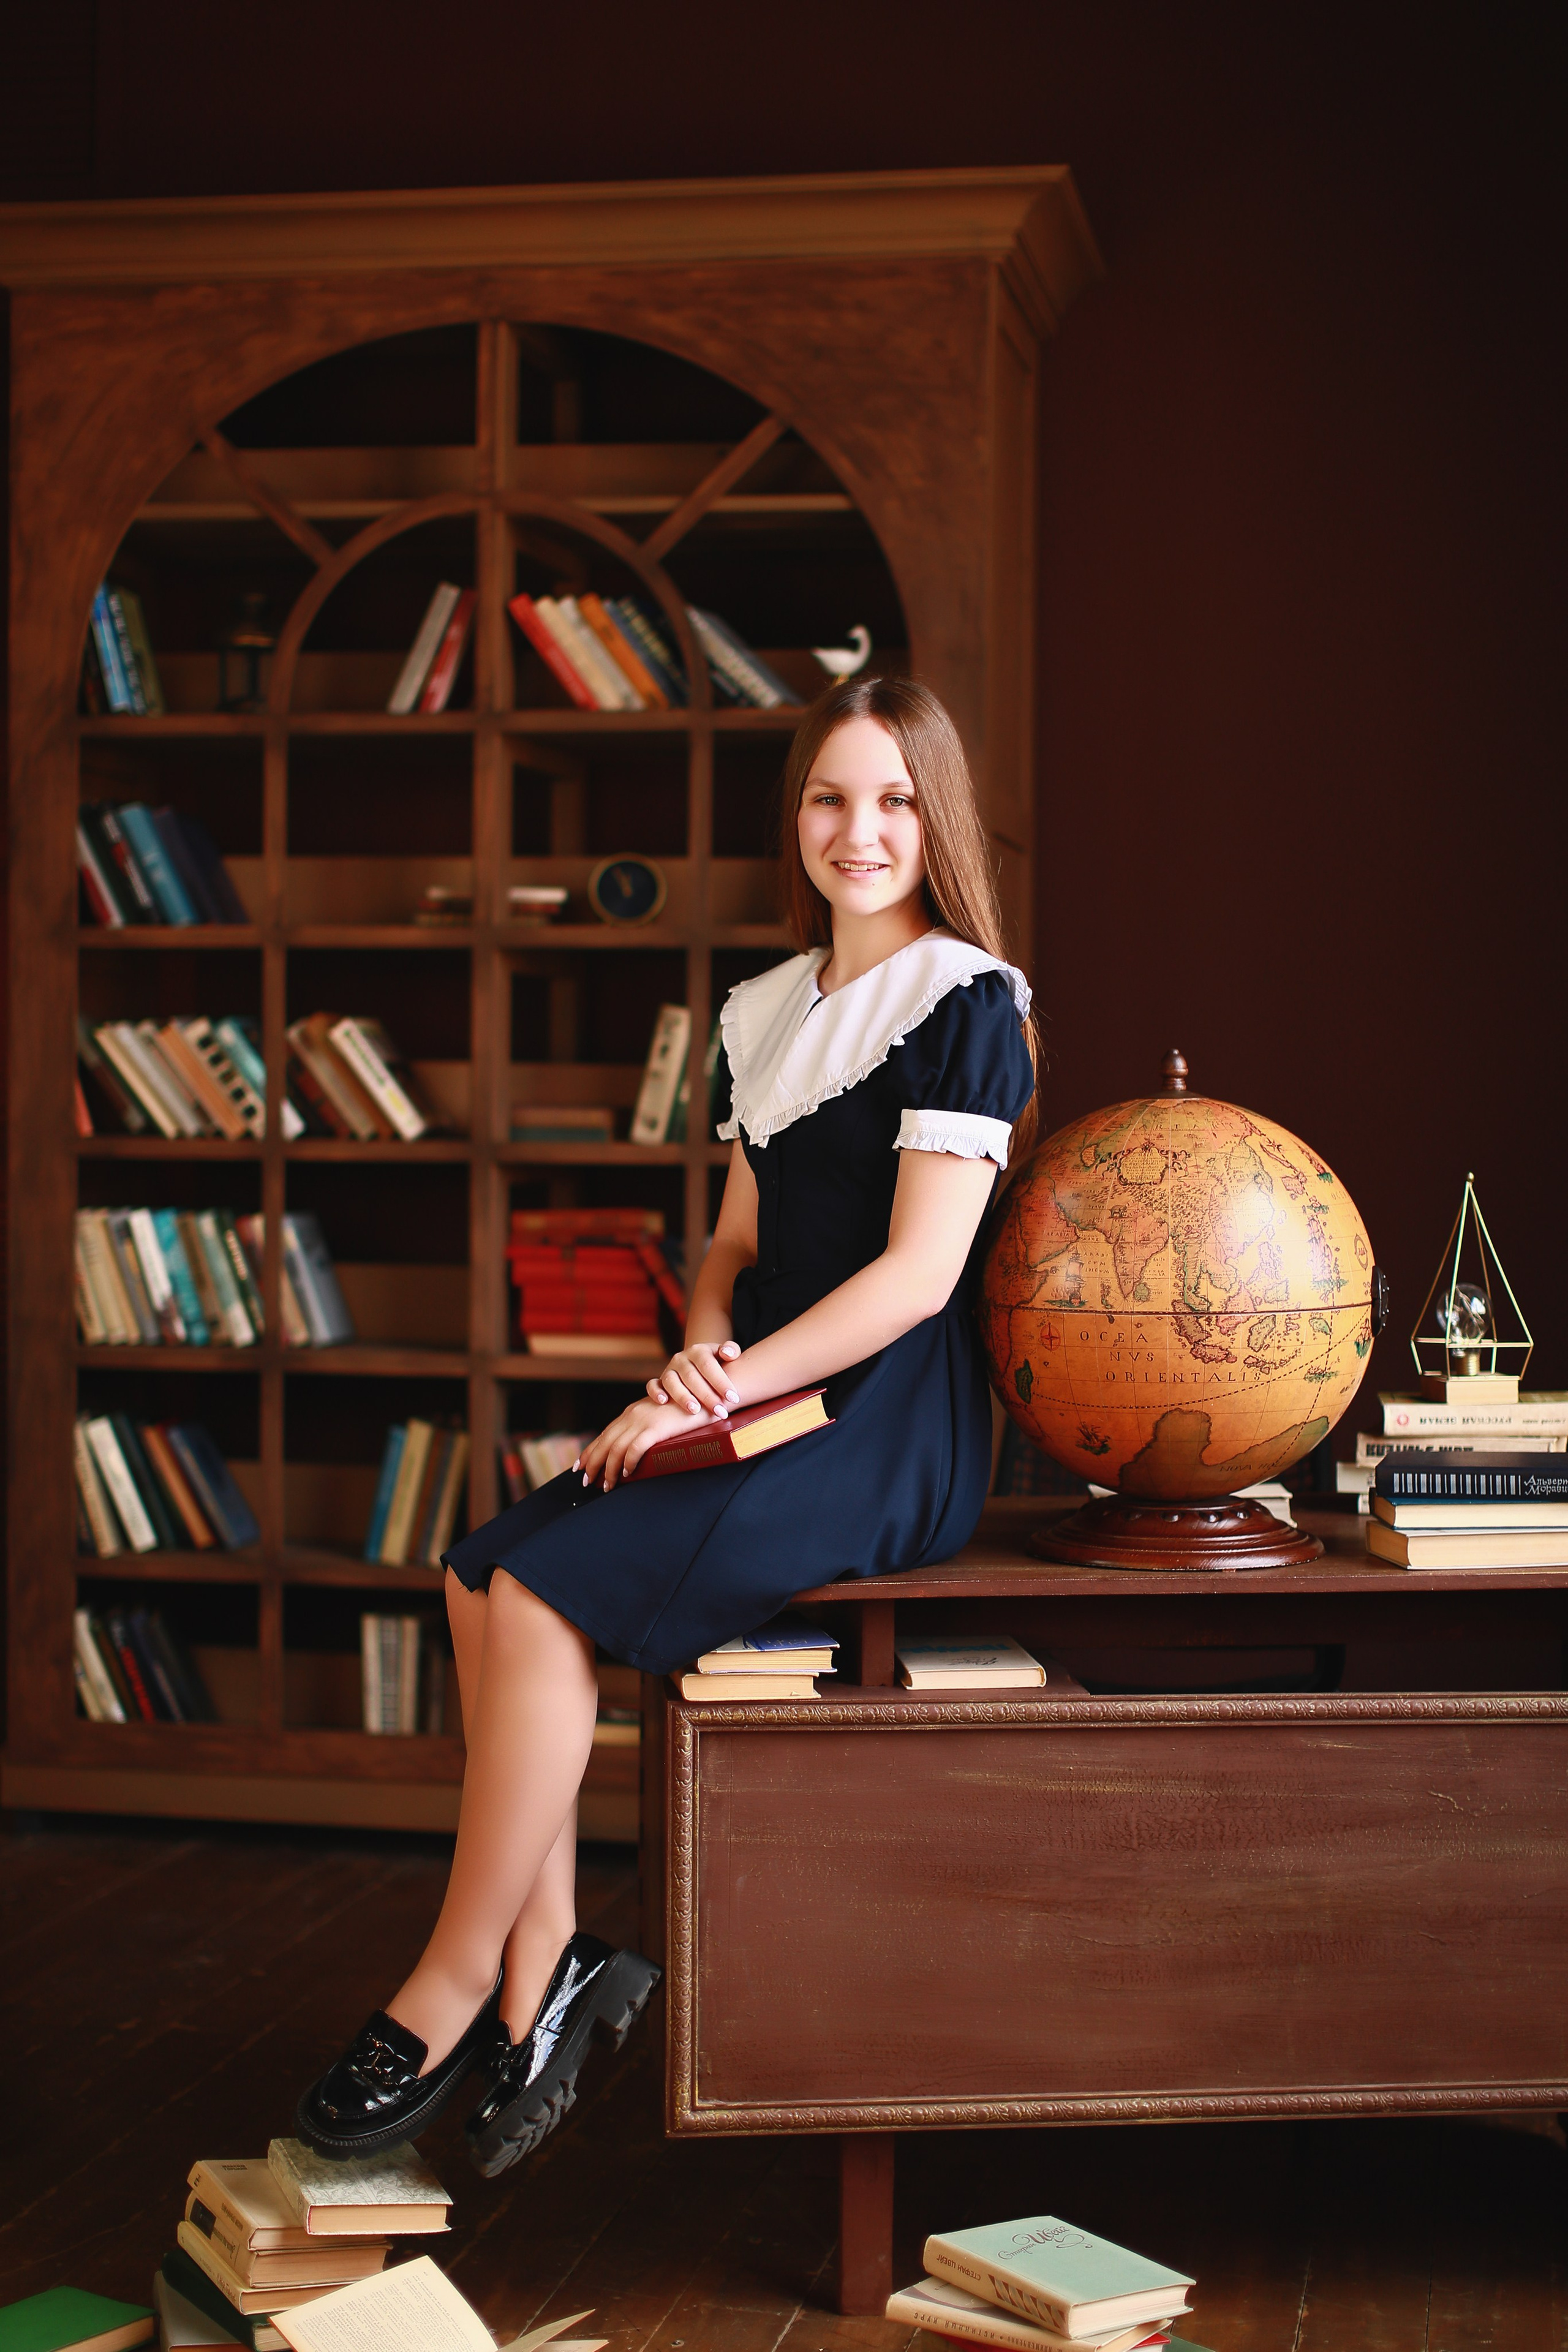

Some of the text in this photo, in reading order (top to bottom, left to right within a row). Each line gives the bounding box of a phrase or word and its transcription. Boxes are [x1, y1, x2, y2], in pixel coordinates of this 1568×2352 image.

[1079, 1330, 1148, 1343] OCEA
[1109, 1351, 1155, 1362] NVS
[1106, 1370, 1261, 1382] ORIENTALIS
[937, 2253, 981, 2282] СТЕФАН ЦВЕЙГ
[913, 2311, 939, 2324] КУРС
[943, 2320, 997, 2340] ИСТИННЫЙ
